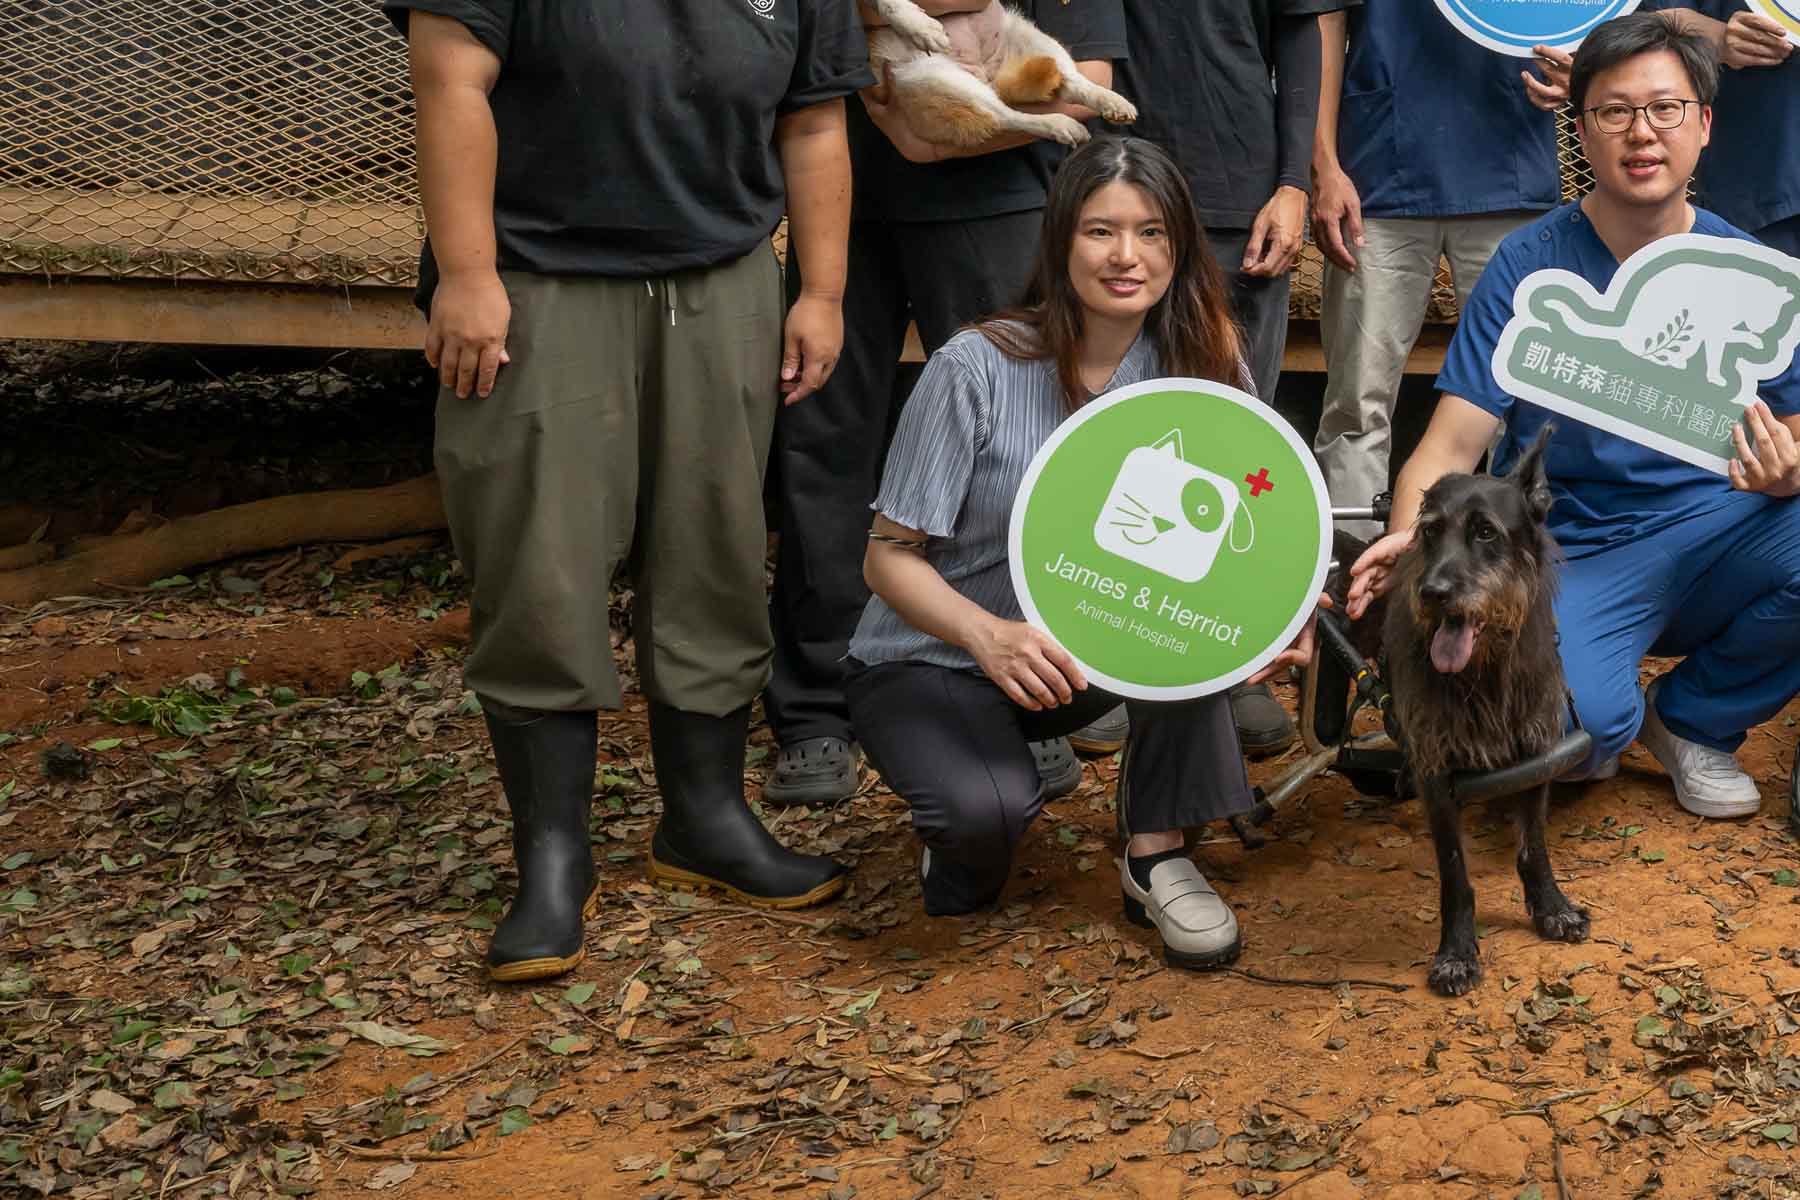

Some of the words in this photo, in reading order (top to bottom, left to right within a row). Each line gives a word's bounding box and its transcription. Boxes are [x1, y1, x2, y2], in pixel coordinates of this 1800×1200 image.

[1045, 553, 1128, 601] James
[1133, 586, 1151, 611] &
[1157, 595, 1243, 647] Herriot
[1074, 599, 1128, 631] Animal
[1128, 620, 1190, 655] Hospital
